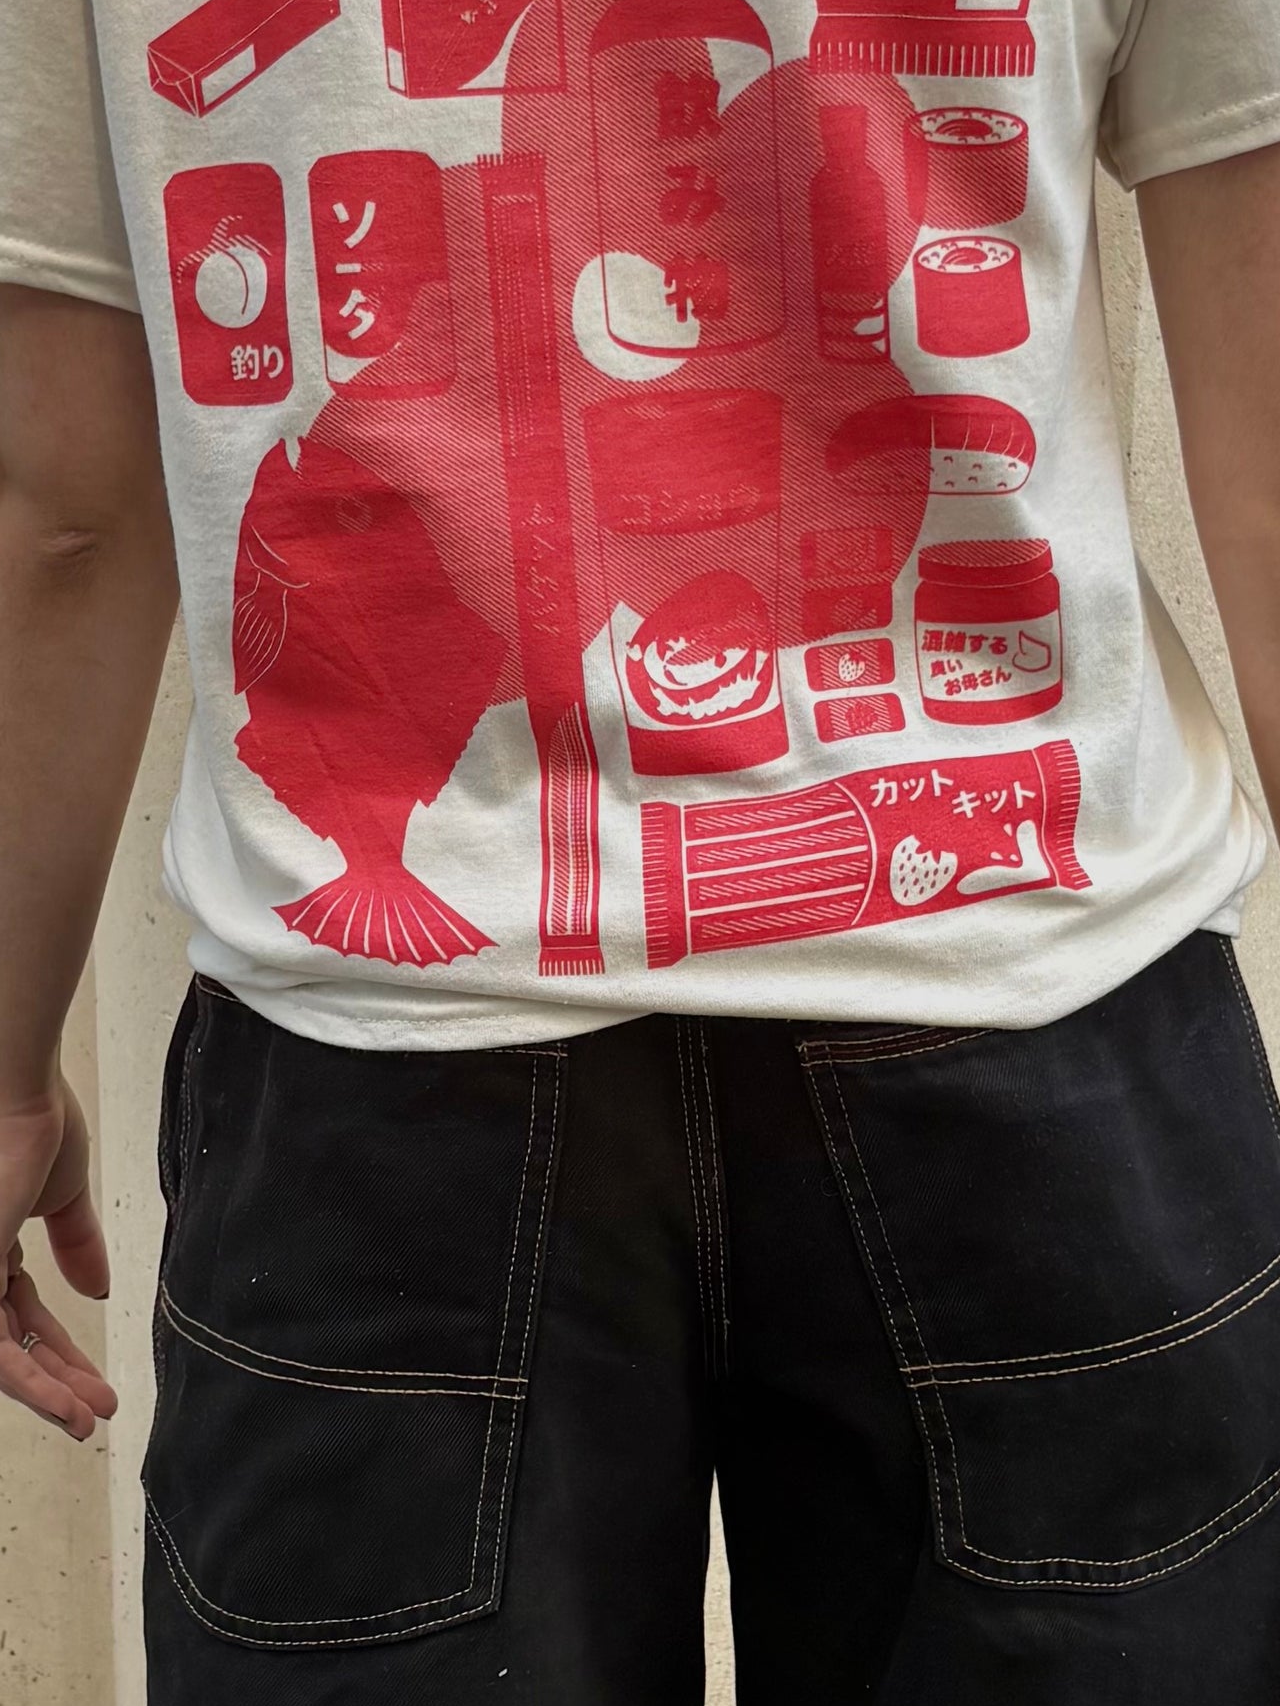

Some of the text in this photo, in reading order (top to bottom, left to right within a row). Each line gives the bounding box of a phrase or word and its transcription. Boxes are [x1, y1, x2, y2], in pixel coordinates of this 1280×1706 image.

[230, 344, 284, 381] 釣り
[944, 666, 1012, 696] お母さん
[870, 768, 954, 808] カット
[951, 780, 1036, 819] キット
